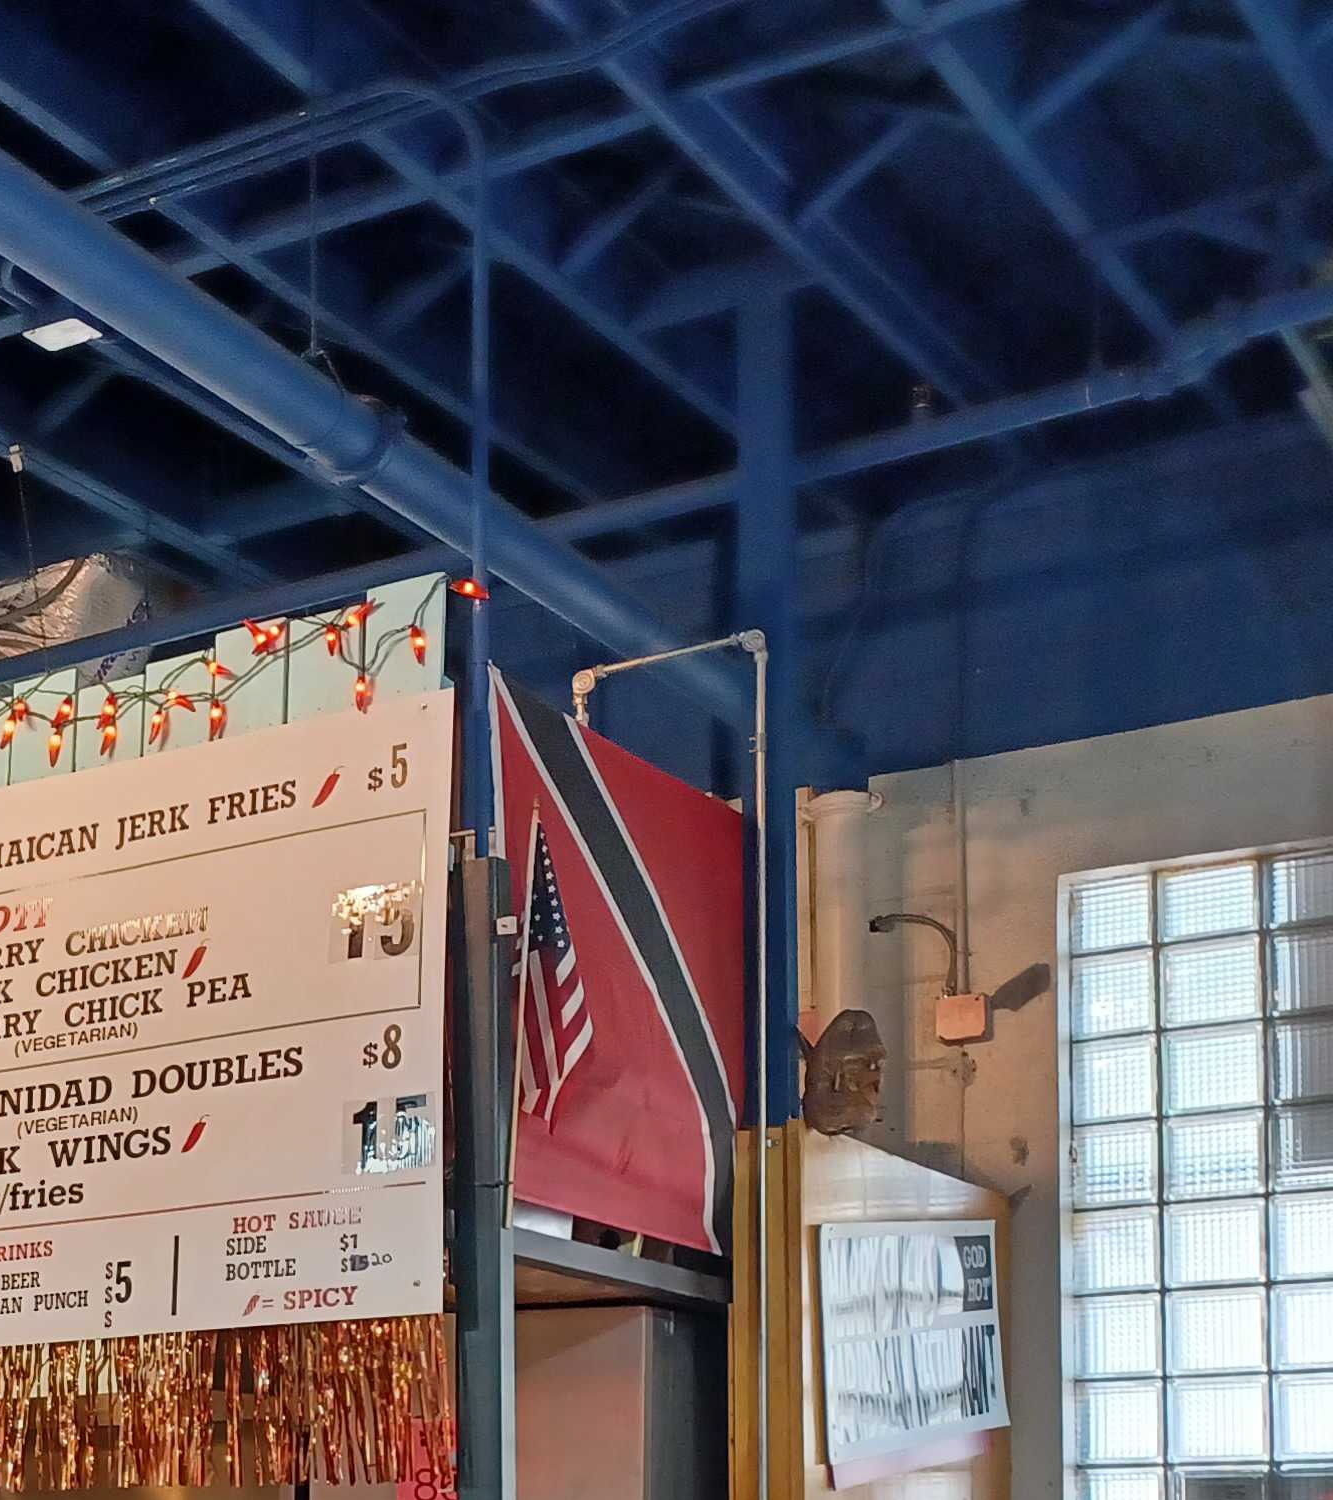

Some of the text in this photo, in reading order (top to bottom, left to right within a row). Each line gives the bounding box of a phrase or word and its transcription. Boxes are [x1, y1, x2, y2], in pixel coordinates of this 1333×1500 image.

[114, 804, 190, 850] JERK
[208, 779, 297, 825] FRIES
[65, 905, 209, 957] CHICKEN
[35, 948, 178, 997] CHICKEN
[64, 988, 163, 1027] CHICK
[186, 973, 252, 1008] PEA
[14, 1022, 139, 1058] (VEGETARIAN)
[131, 1046, 304, 1100] DOUBLES
[363, 1023, 403, 1070] $8
[16, 1106, 139, 1140] (VEGETARIAN)
[47, 1125, 173, 1168] WINGS
[232, 1214, 277, 1235] HOT
[288, 1206, 363, 1230] SAUCE
[225, 1233, 358, 1256] SIDE $1
[963, 1245, 988, 1269] GOD
[1, 1271, 41, 1291] BEER
[225, 1258, 297, 1282] BOTTLE
[33, 1290, 89, 1312] PUNCH
[282, 1285, 358, 1311] SPICY
